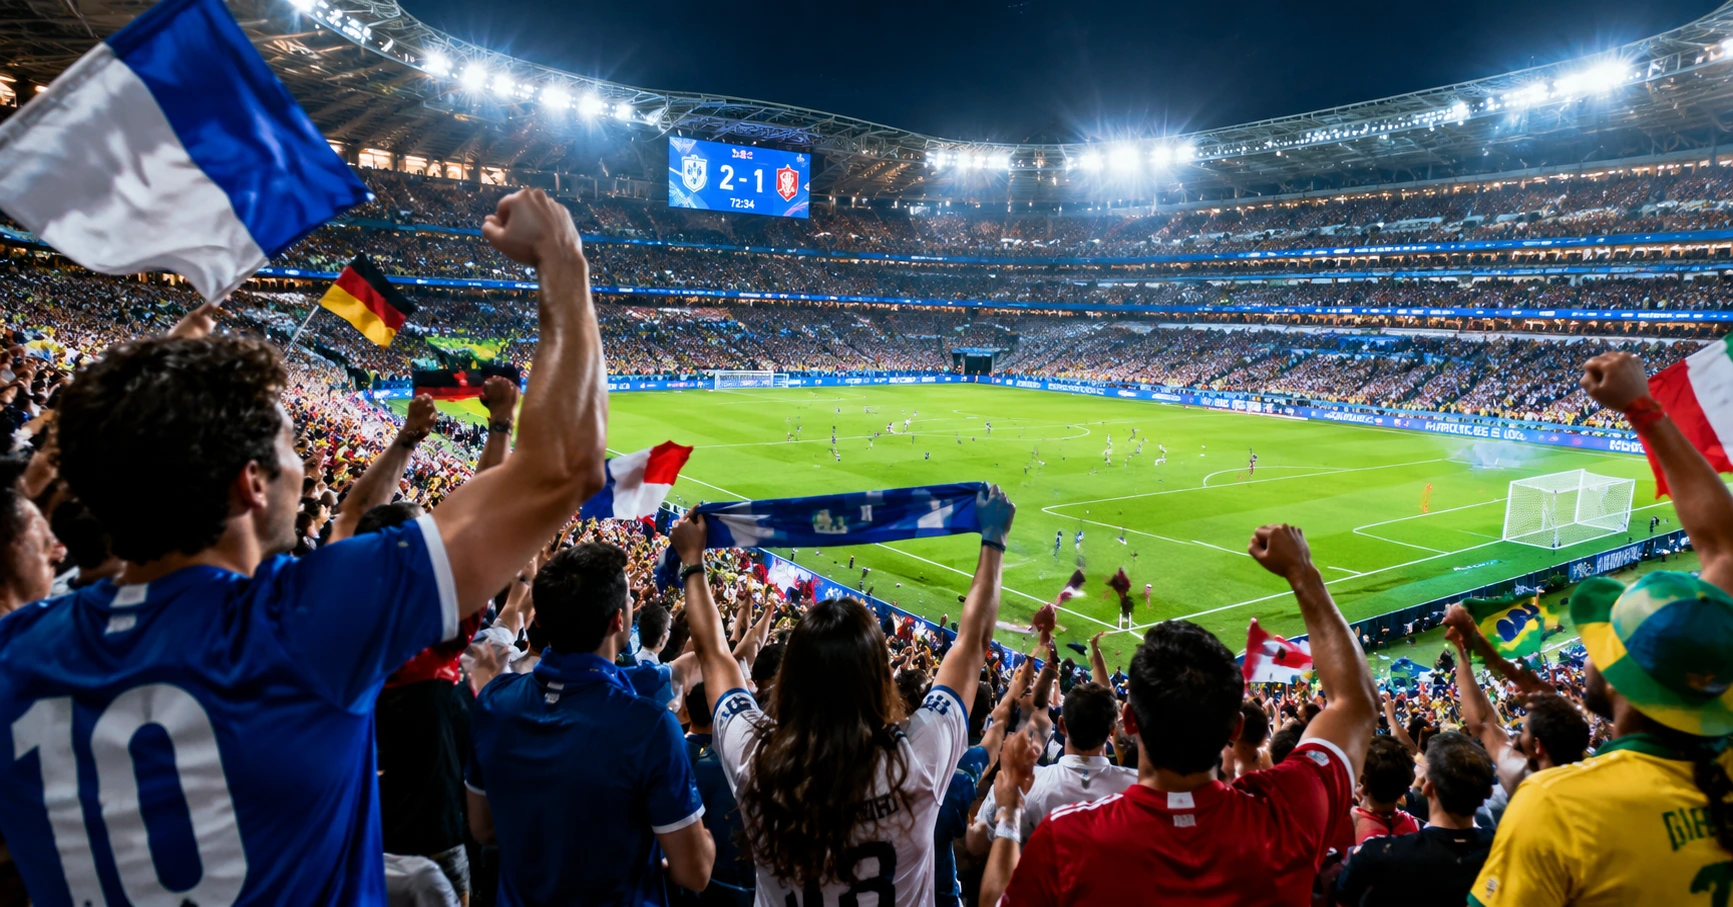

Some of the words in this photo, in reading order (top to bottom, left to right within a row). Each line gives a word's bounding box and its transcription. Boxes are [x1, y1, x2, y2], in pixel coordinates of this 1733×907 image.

[719, 164, 735, 191] 2
[753, 168, 764, 193] 1
[729, 197, 755, 209] 72:34
[11, 682, 248, 907] 10
